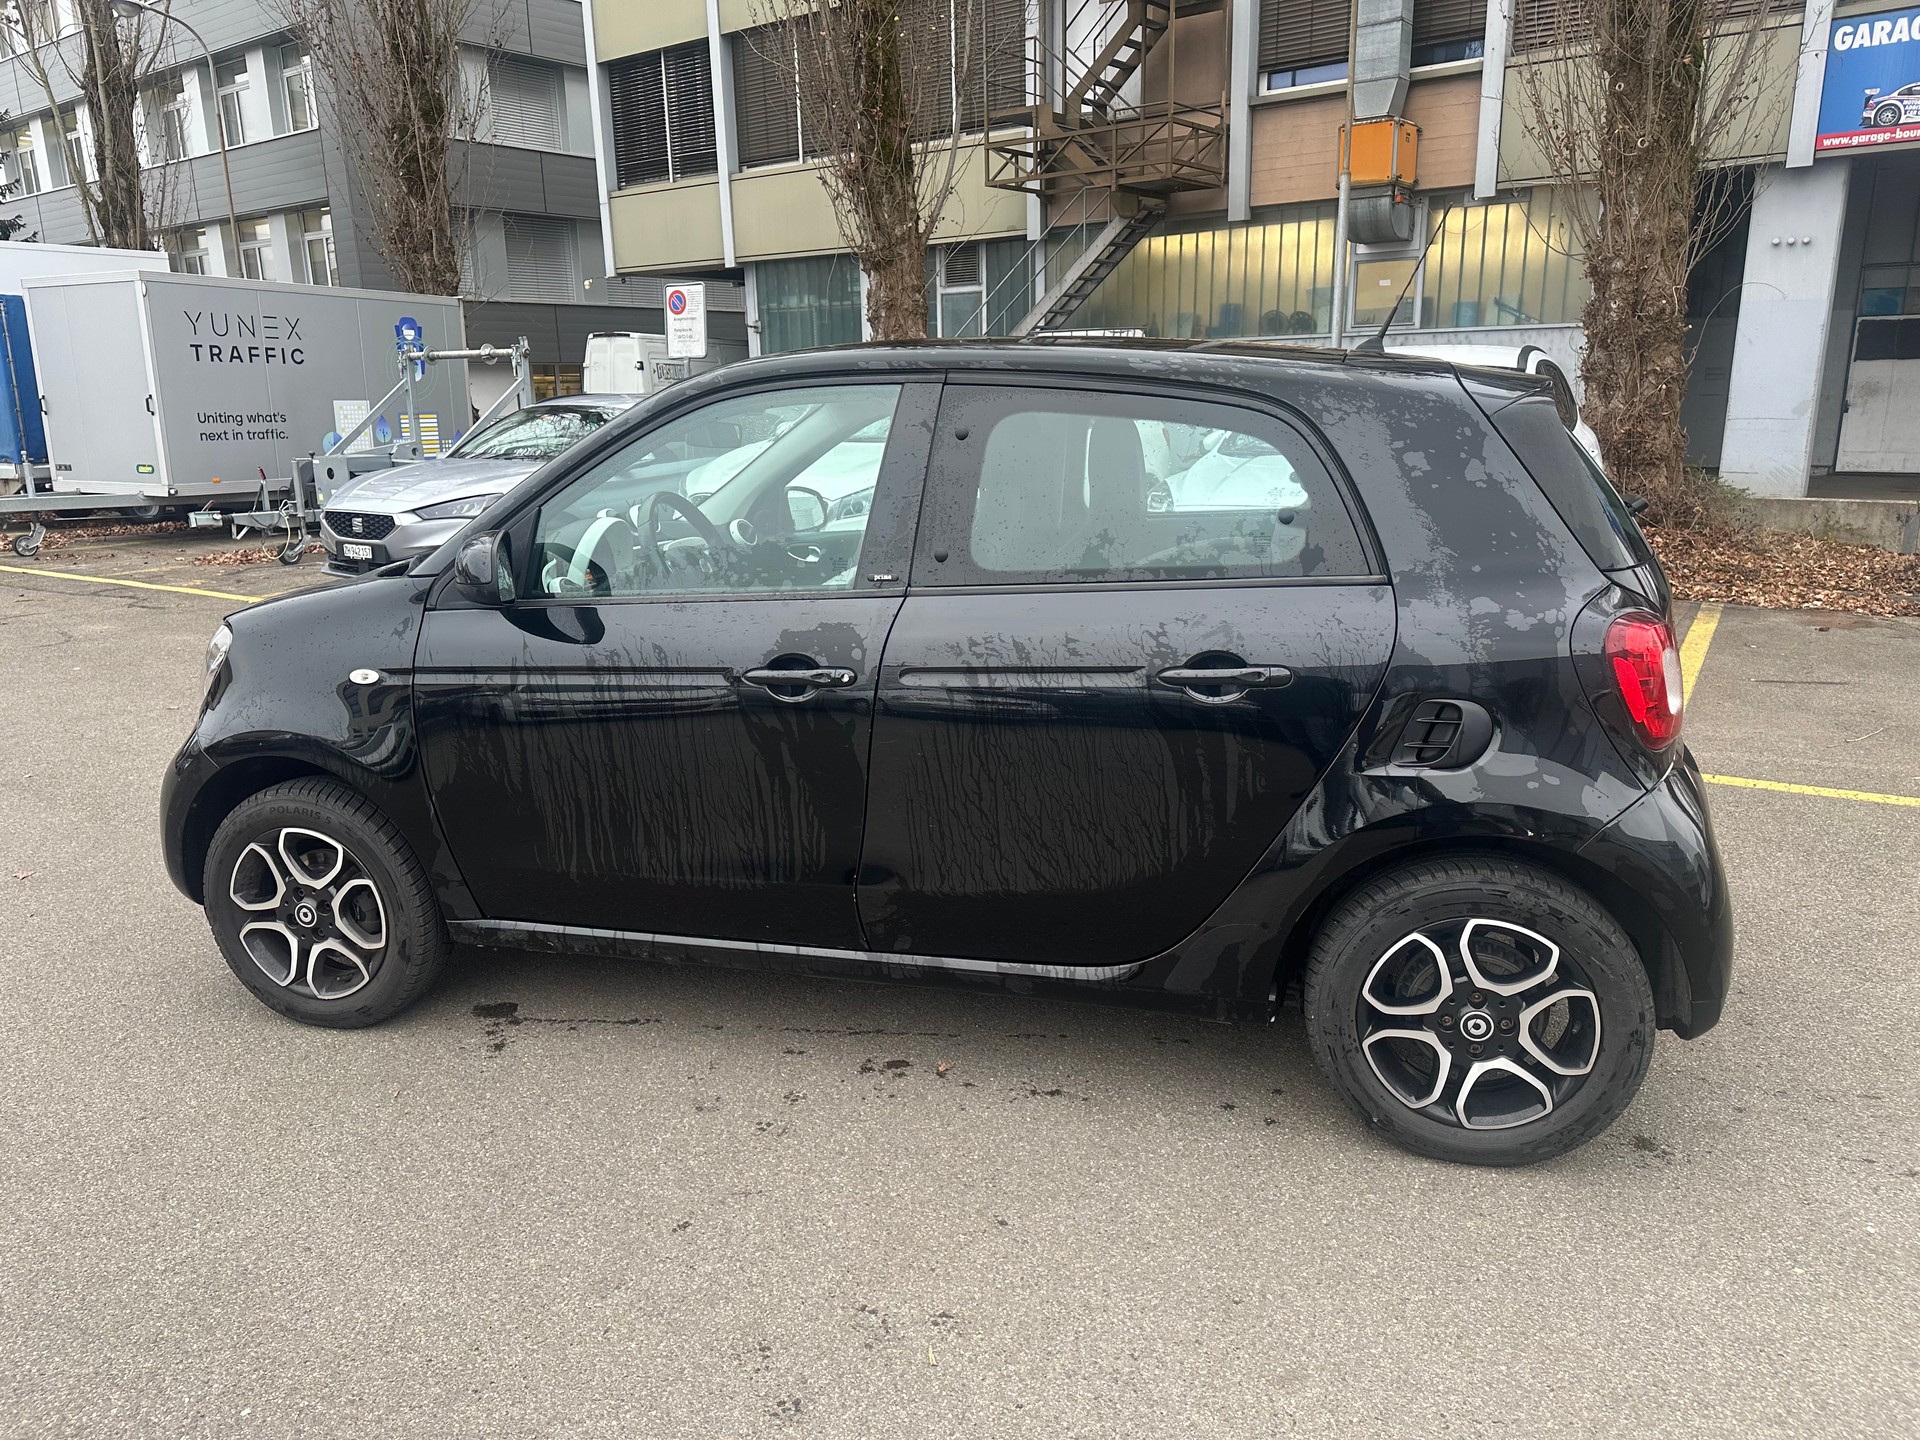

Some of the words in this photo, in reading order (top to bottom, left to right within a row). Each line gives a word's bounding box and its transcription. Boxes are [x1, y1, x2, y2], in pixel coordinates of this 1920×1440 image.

[184, 311, 302, 341] YUNEX
[189, 344, 305, 365] TRAFFIC
[197, 411, 244, 427] Uniting
[246, 411, 287, 423] what's
[200, 430, 229, 441] next
[232, 428, 244, 440] in
[246, 428, 289, 440] traffic.
[269, 805, 321, 820] POLARIS
